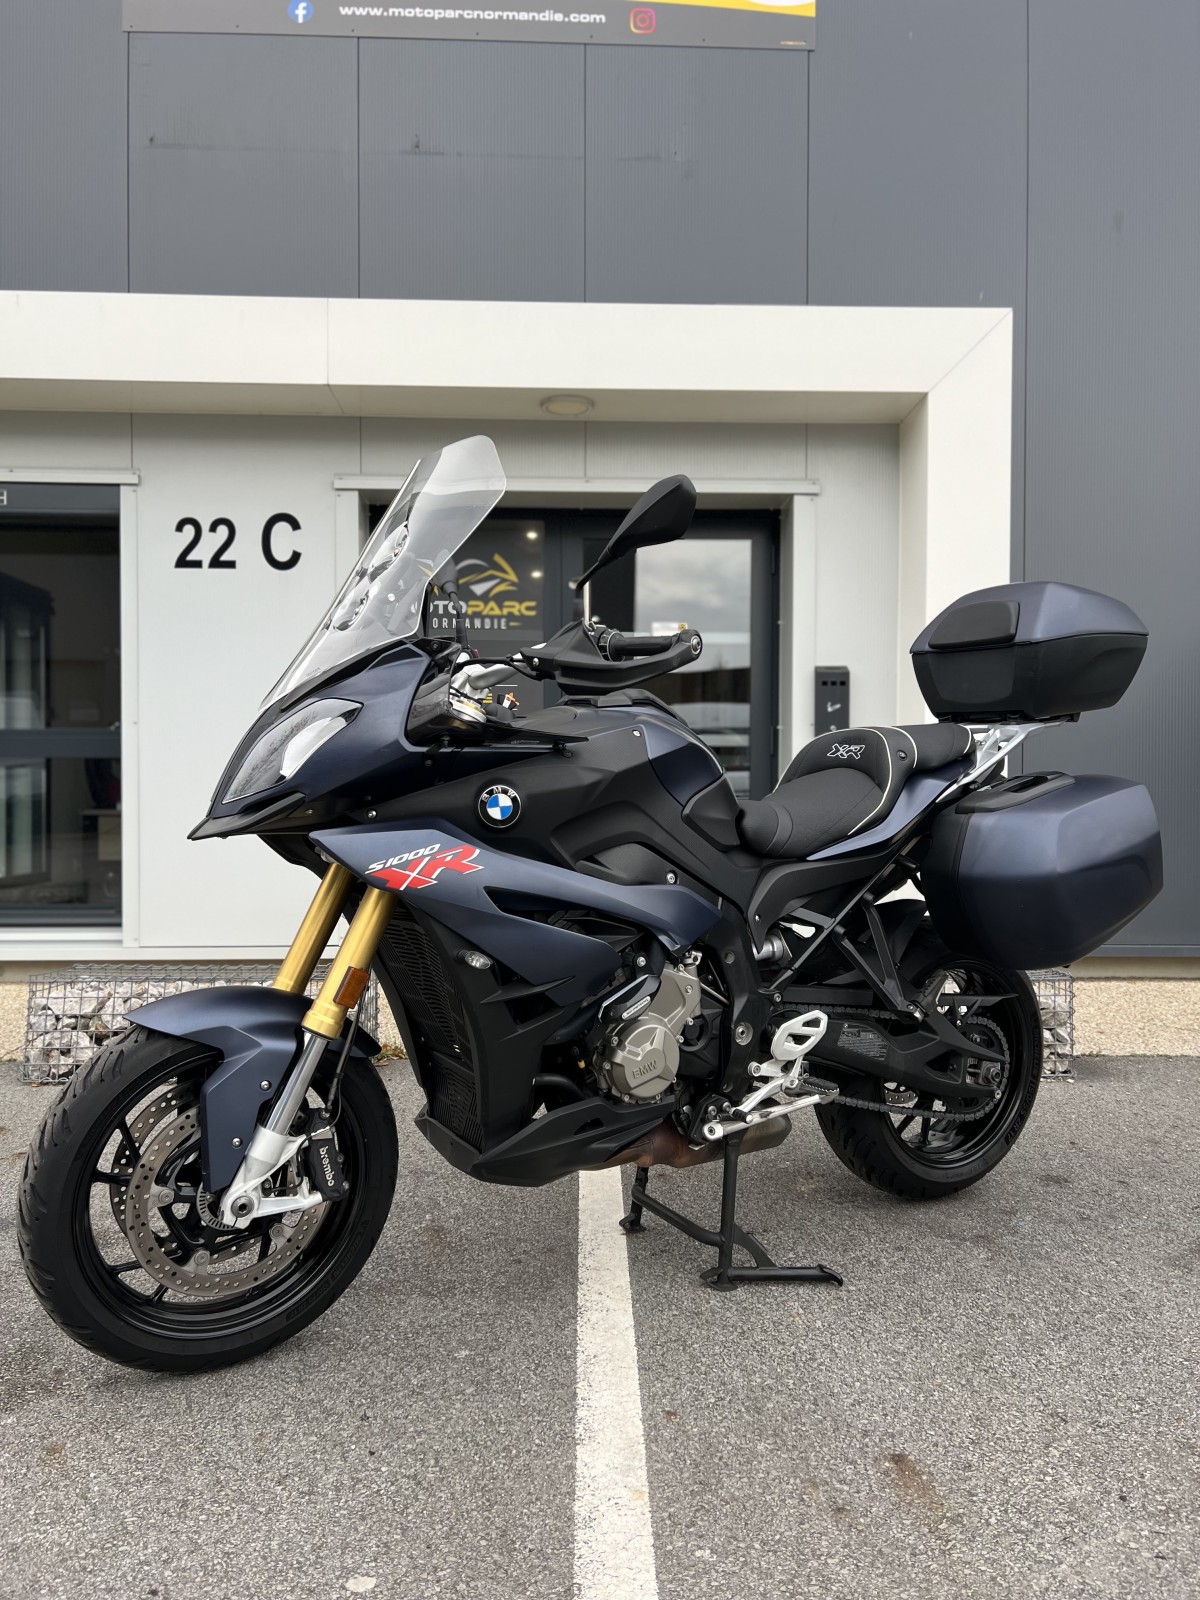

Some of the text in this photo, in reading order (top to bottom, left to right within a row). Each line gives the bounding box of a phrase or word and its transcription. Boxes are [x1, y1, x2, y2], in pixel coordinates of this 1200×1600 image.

[339, 6, 606, 23] www.motoparcnormandie.com
[174, 512, 302, 571] 22 C
[828, 743, 866, 760] XR
[481, 786, 516, 802] BMW
[370, 844, 485, 891] XR
[632, 1059, 657, 1080] BMW
[319, 1145, 336, 1187] brembo
